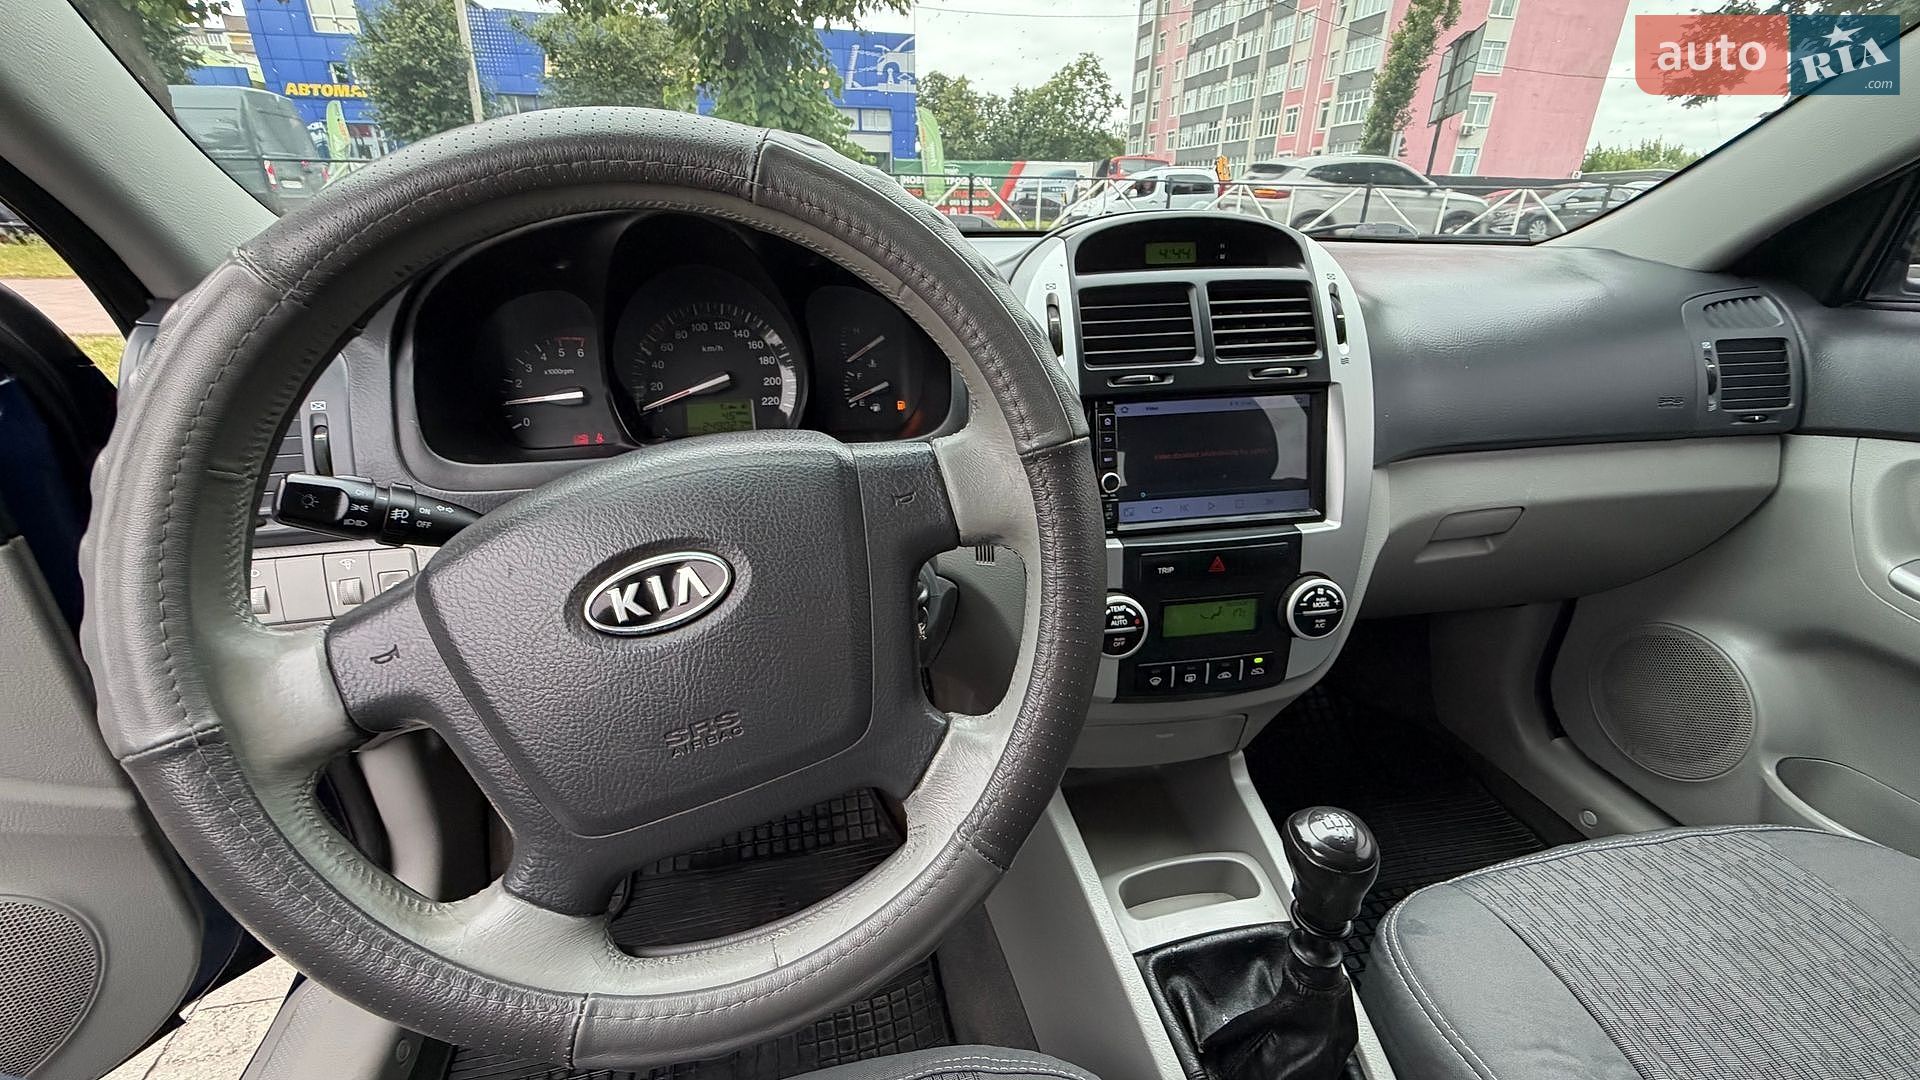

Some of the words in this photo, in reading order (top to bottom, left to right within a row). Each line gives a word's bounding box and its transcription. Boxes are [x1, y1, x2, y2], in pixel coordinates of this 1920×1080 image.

[691, 322, 709, 332] 100
[713, 321, 731, 331] 120
[675, 330, 688, 340] 80
[733, 329, 750, 338] 140
[702, 344, 724, 352] km/h
[747, 340, 764, 350] 160
[558, 348, 566, 357] 5
[577, 348, 585, 358] 6
[651, 360, 665, 369] 40
[759, 356, 776, 365] 180
[525, 363, 533, 373] 3
[514, 379, 523, 388] 2
[650, 381, 664, 391] 20
[763, 377, 782, 386] 200
[761, 396, 780, 406] 220
[523, 417, 531, 427] 0
[418, 507, 431, 515] ON
[415, 520, 433, 529] OFF
[1157, 566, 1175, 575] TRIP
[606, 566, 712, 625] KIA
[1109, 604, 1127, 613] TEMP
[1110, 619, 1128, 627] AUTO
[1112, 640, 1126, 648] OFF
[664, 711, 741, 747] SRS
[672, 726, 744, 759] AIRBAG
